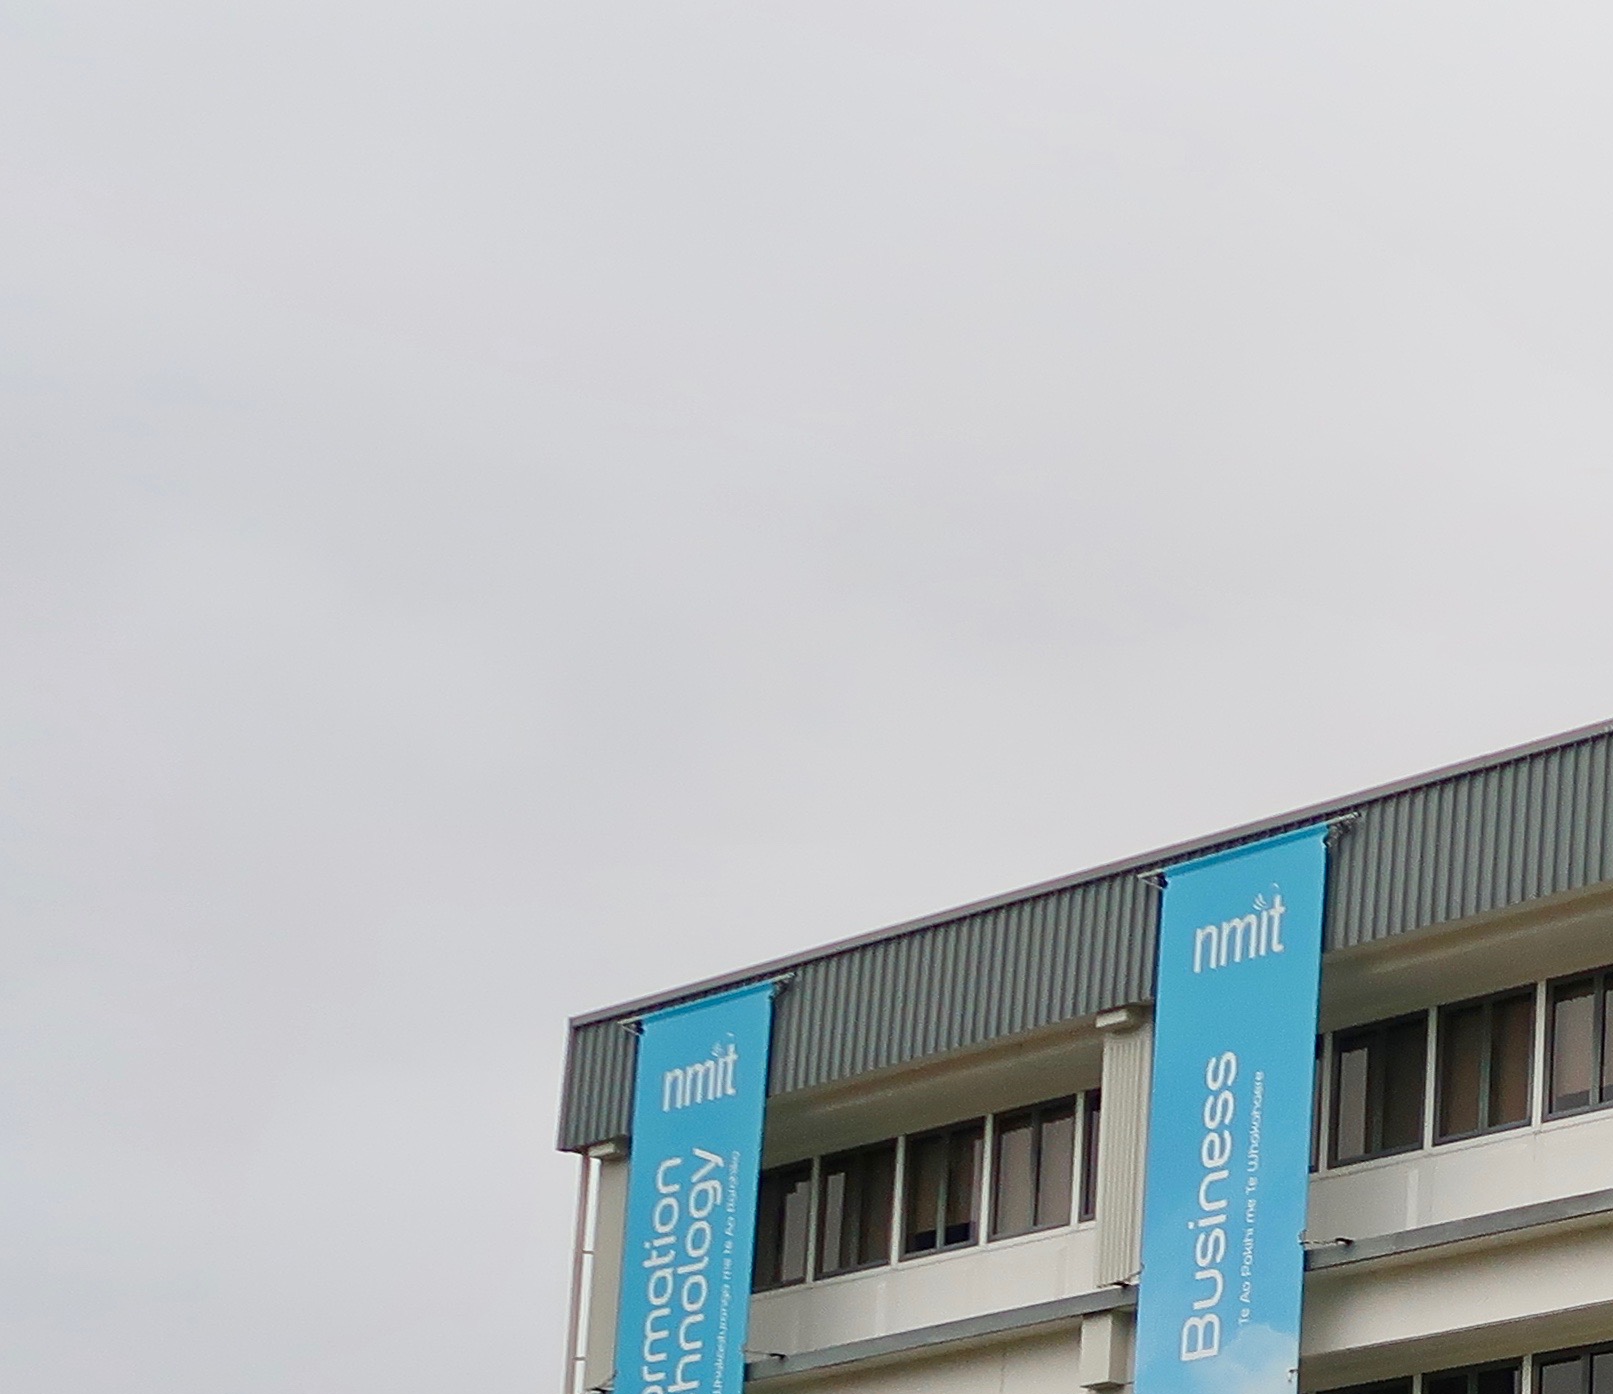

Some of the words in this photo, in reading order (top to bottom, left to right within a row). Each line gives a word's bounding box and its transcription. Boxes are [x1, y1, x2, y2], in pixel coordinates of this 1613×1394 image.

[1193, 892, 1286, 974] nmit
[662, 1040, 739, 1113] nmit
[1180, 1051, 1238, 1362] Business
